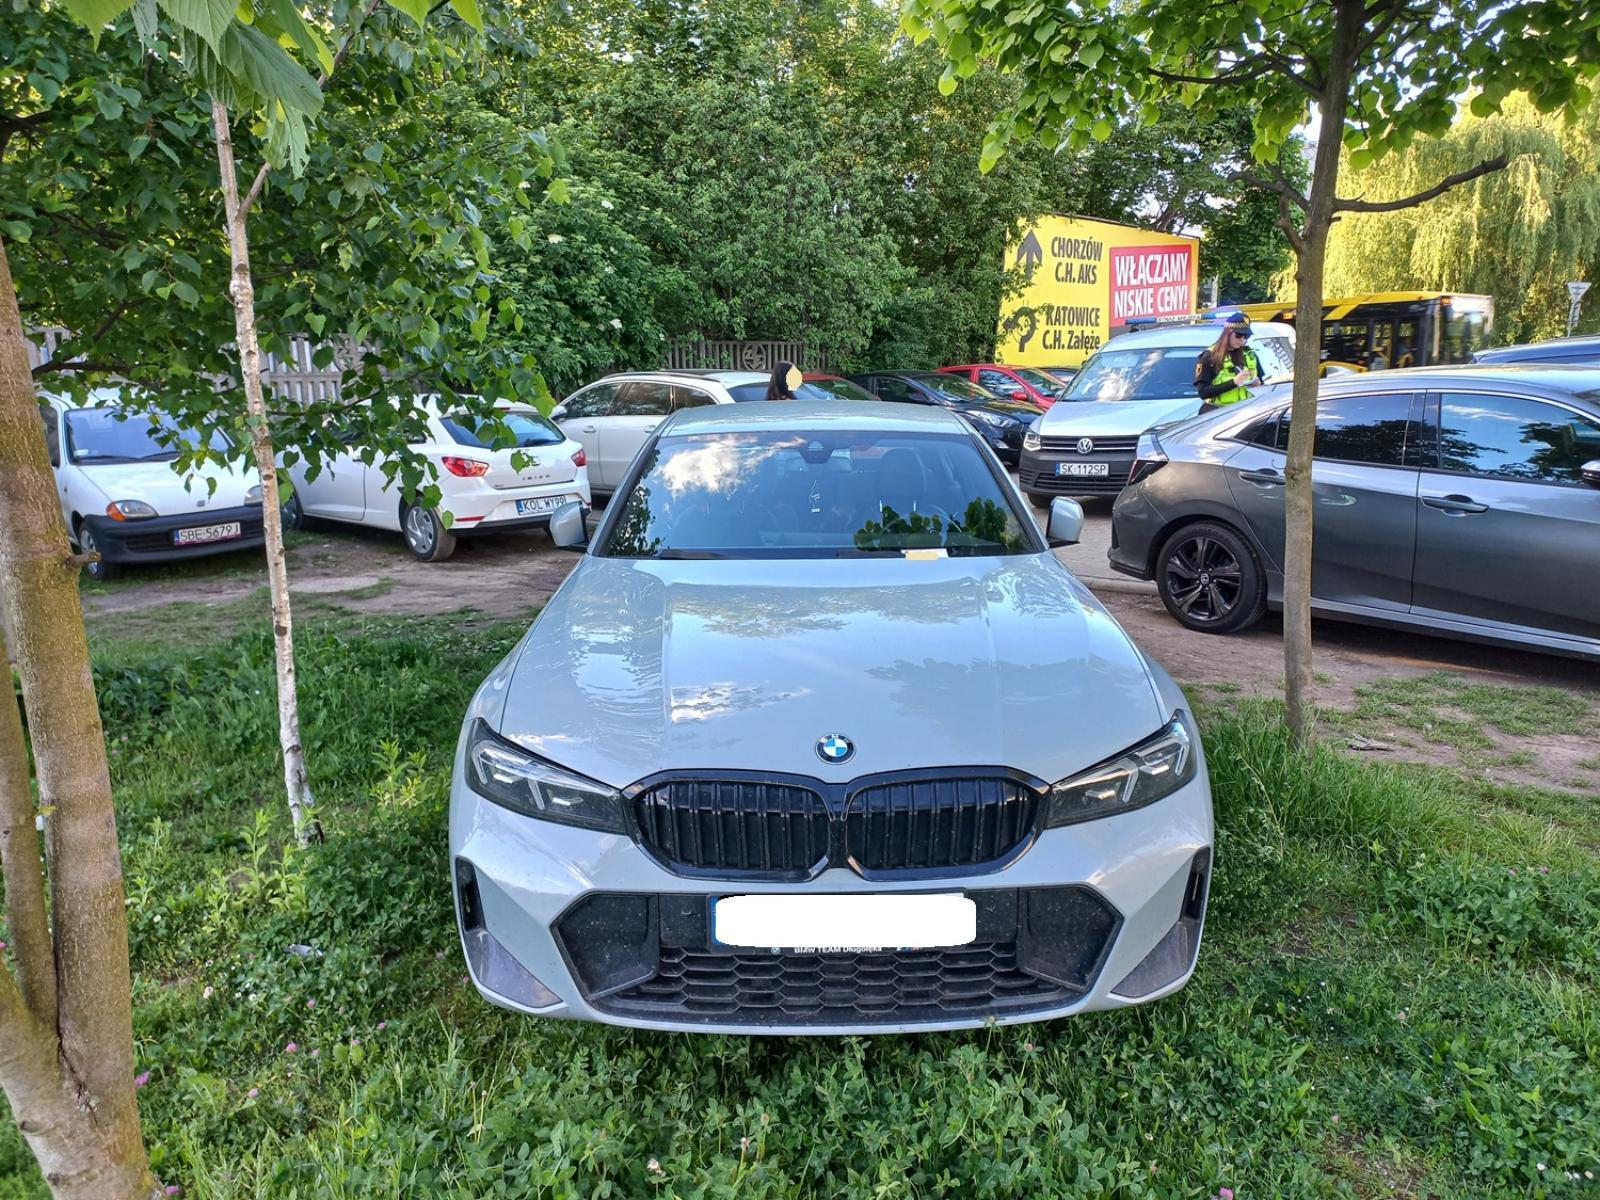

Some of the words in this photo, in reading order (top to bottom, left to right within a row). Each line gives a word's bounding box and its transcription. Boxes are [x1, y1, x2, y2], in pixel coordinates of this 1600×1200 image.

[1051, 236, 1103, 262] CHORZÓW
[1055, 262, 1075, 283] C.H.
[1077, 264, 1097, 285] AKS
[1115, 253, 1189, 286] WŁĄCZAMY
[1114, 287, 1154, 318] NISKIE
[1157, 286, 1188, 311] CENY!
[1046, 306, 1100, 327] KATOWICE
[1042, 330, 1065, 350] C.H.
[1067, 330, 1100, 354] Załęże
